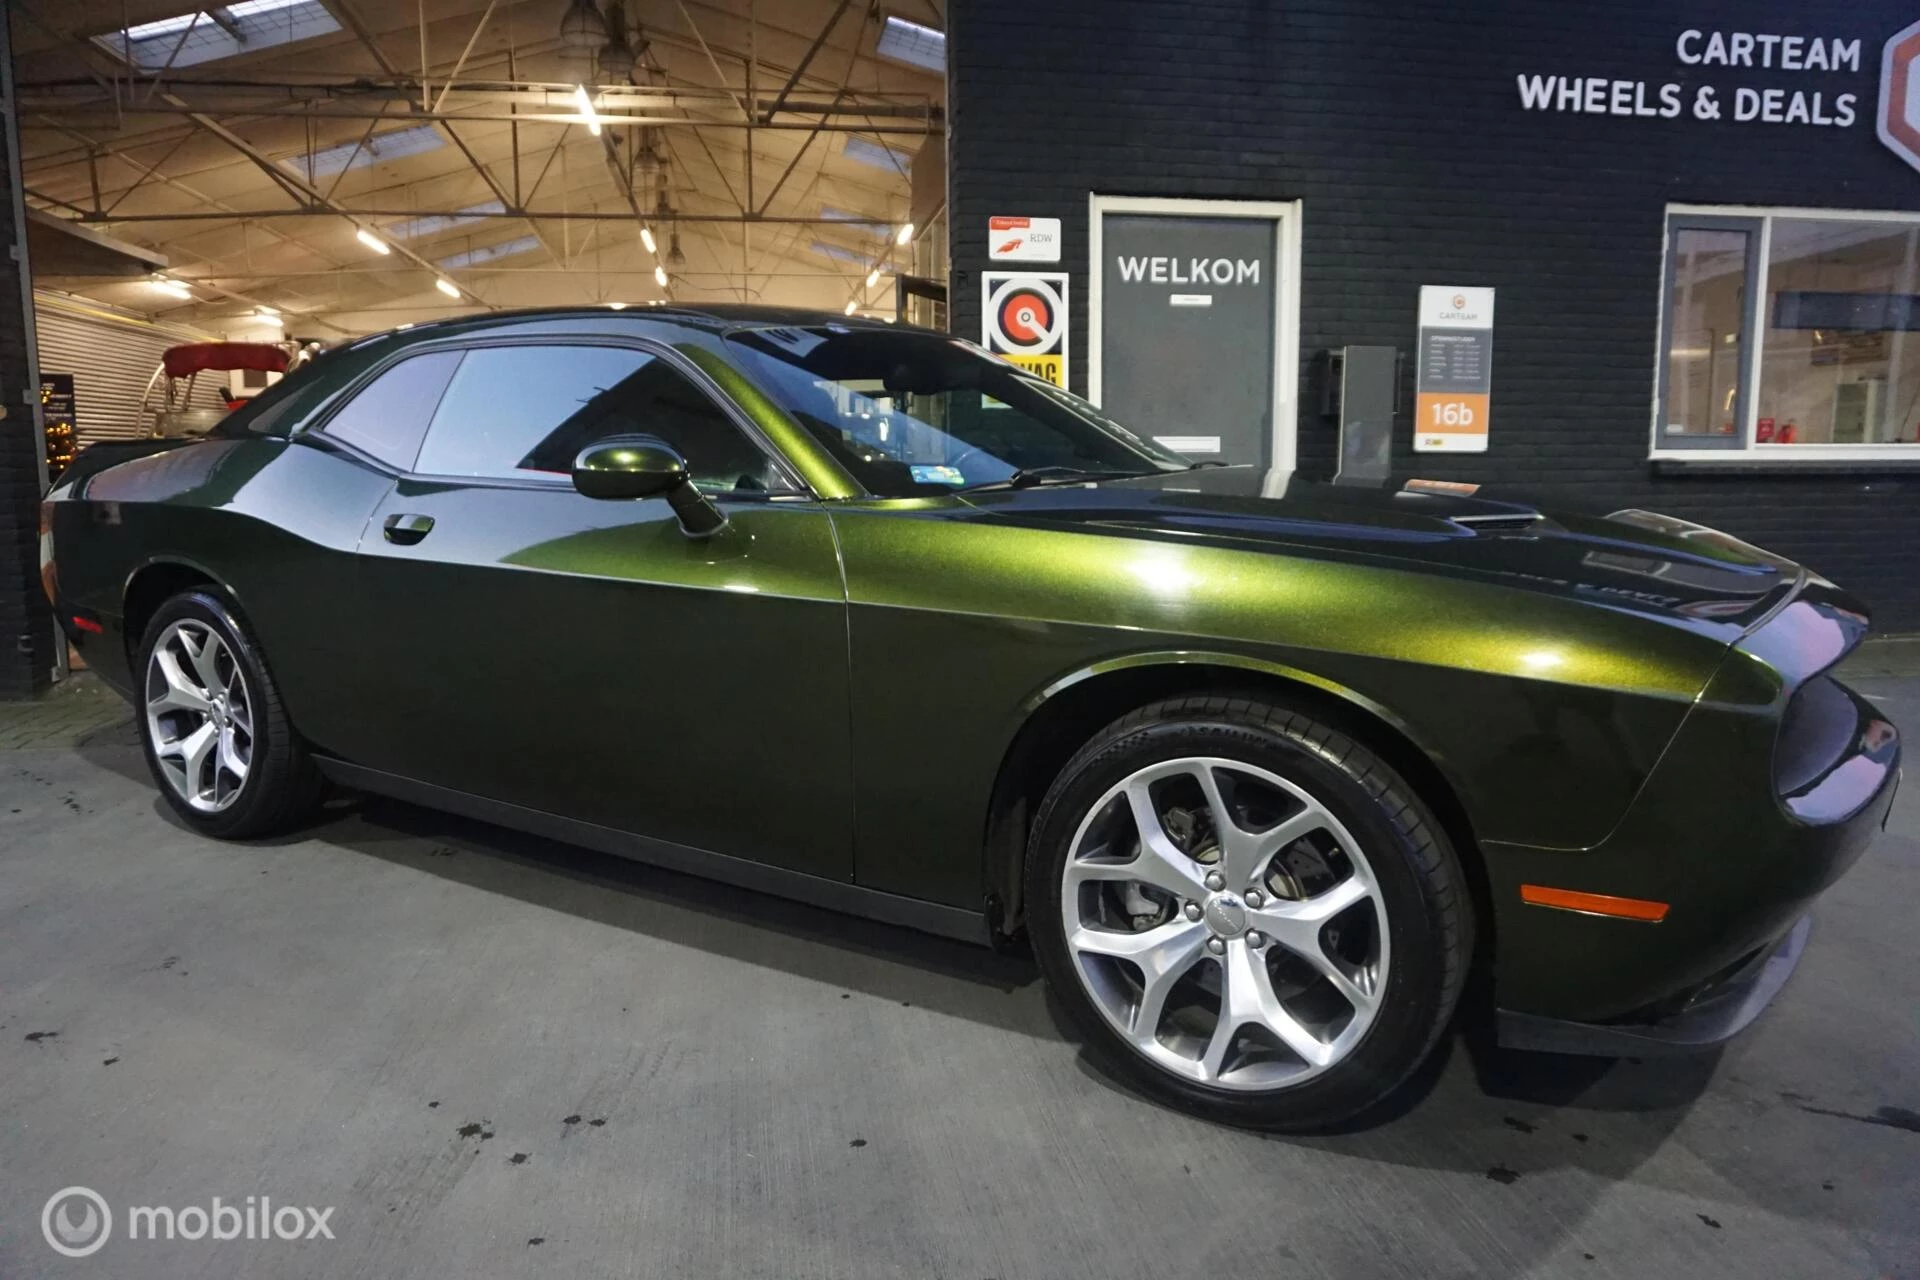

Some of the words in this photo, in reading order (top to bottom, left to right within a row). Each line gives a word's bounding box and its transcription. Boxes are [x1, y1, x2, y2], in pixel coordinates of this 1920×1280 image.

[1676, 29, 1861, 72] CARTEAM
[1517, 73, 1682, 118] WHEELS
[1692, 86, 1721, 120] &
[1734, 88, 1857, 127] DEALS
[1029, 233, 1053, 242] RDW
[1117, 256, 1260, 284] WELKOM
[1432, 402, 1474, 426] 16b
